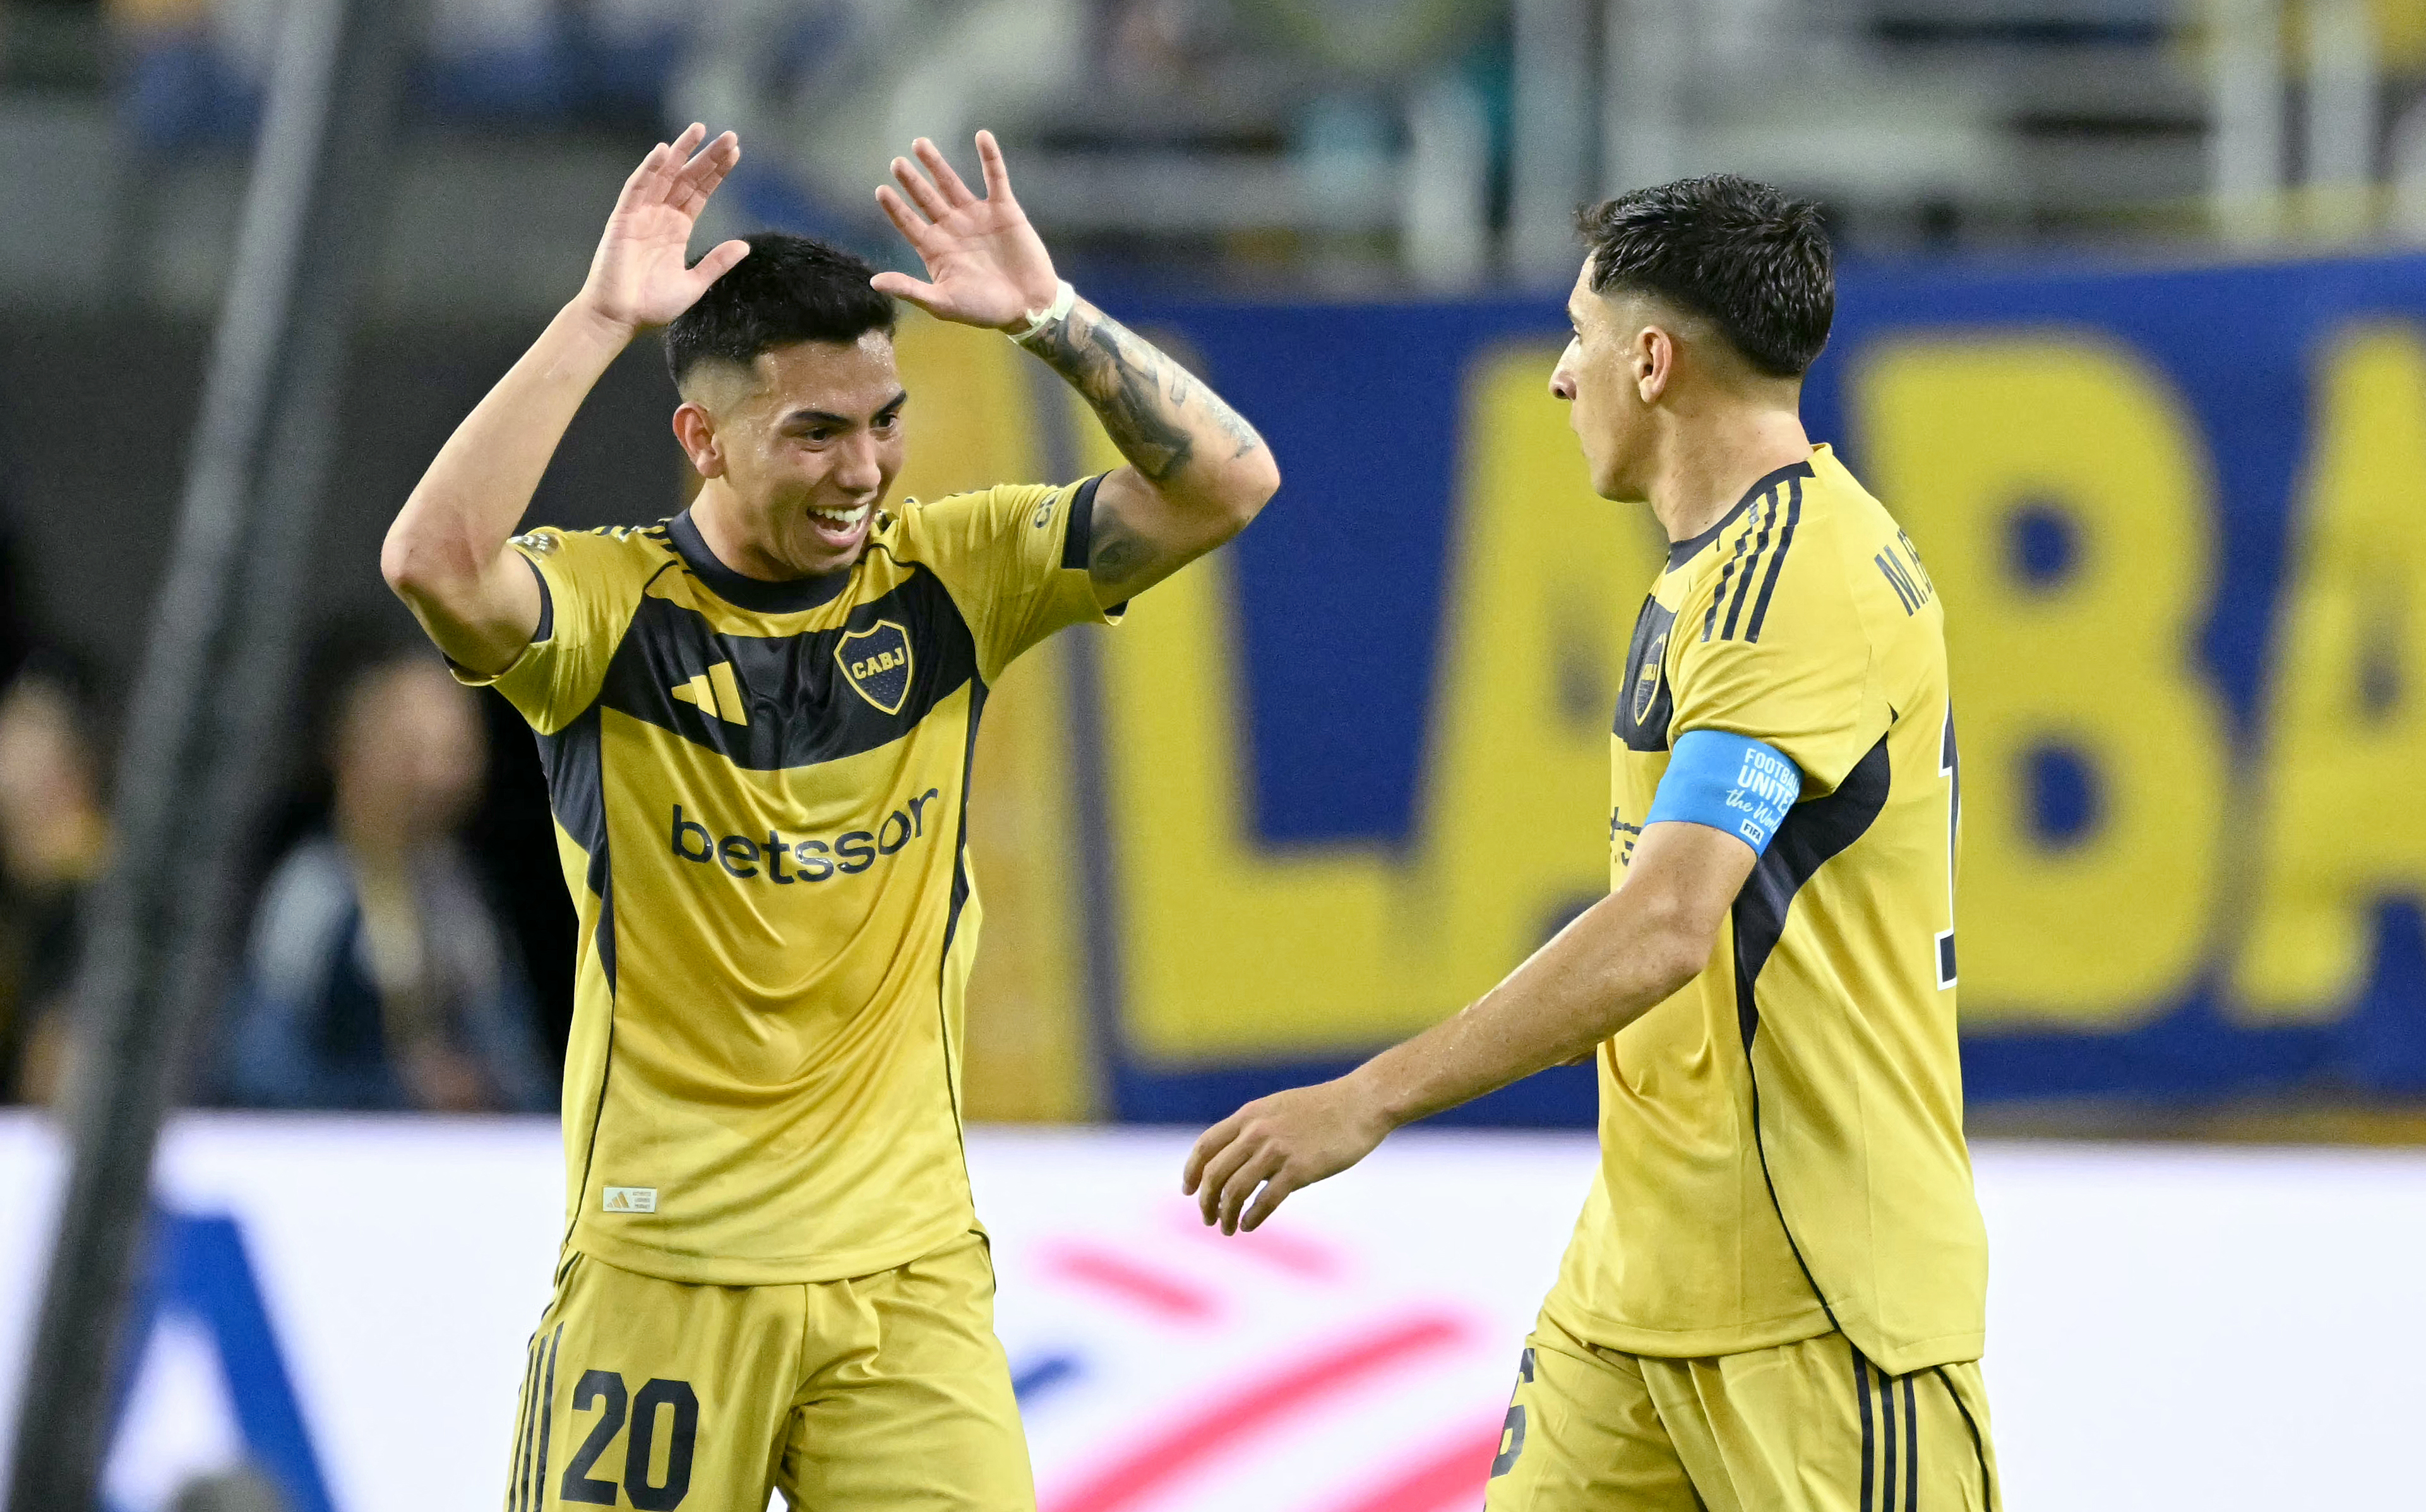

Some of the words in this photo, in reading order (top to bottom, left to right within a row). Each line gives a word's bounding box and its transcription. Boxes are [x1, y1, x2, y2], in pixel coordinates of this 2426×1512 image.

[852, 647, 905, 679] CABJ
[1726, 789, 1754, 812] the
[671, 787, 938, 884] betssor
[1743, 823, 1761, 842] FIFA
[559, 1369, 700, 1512] 20
